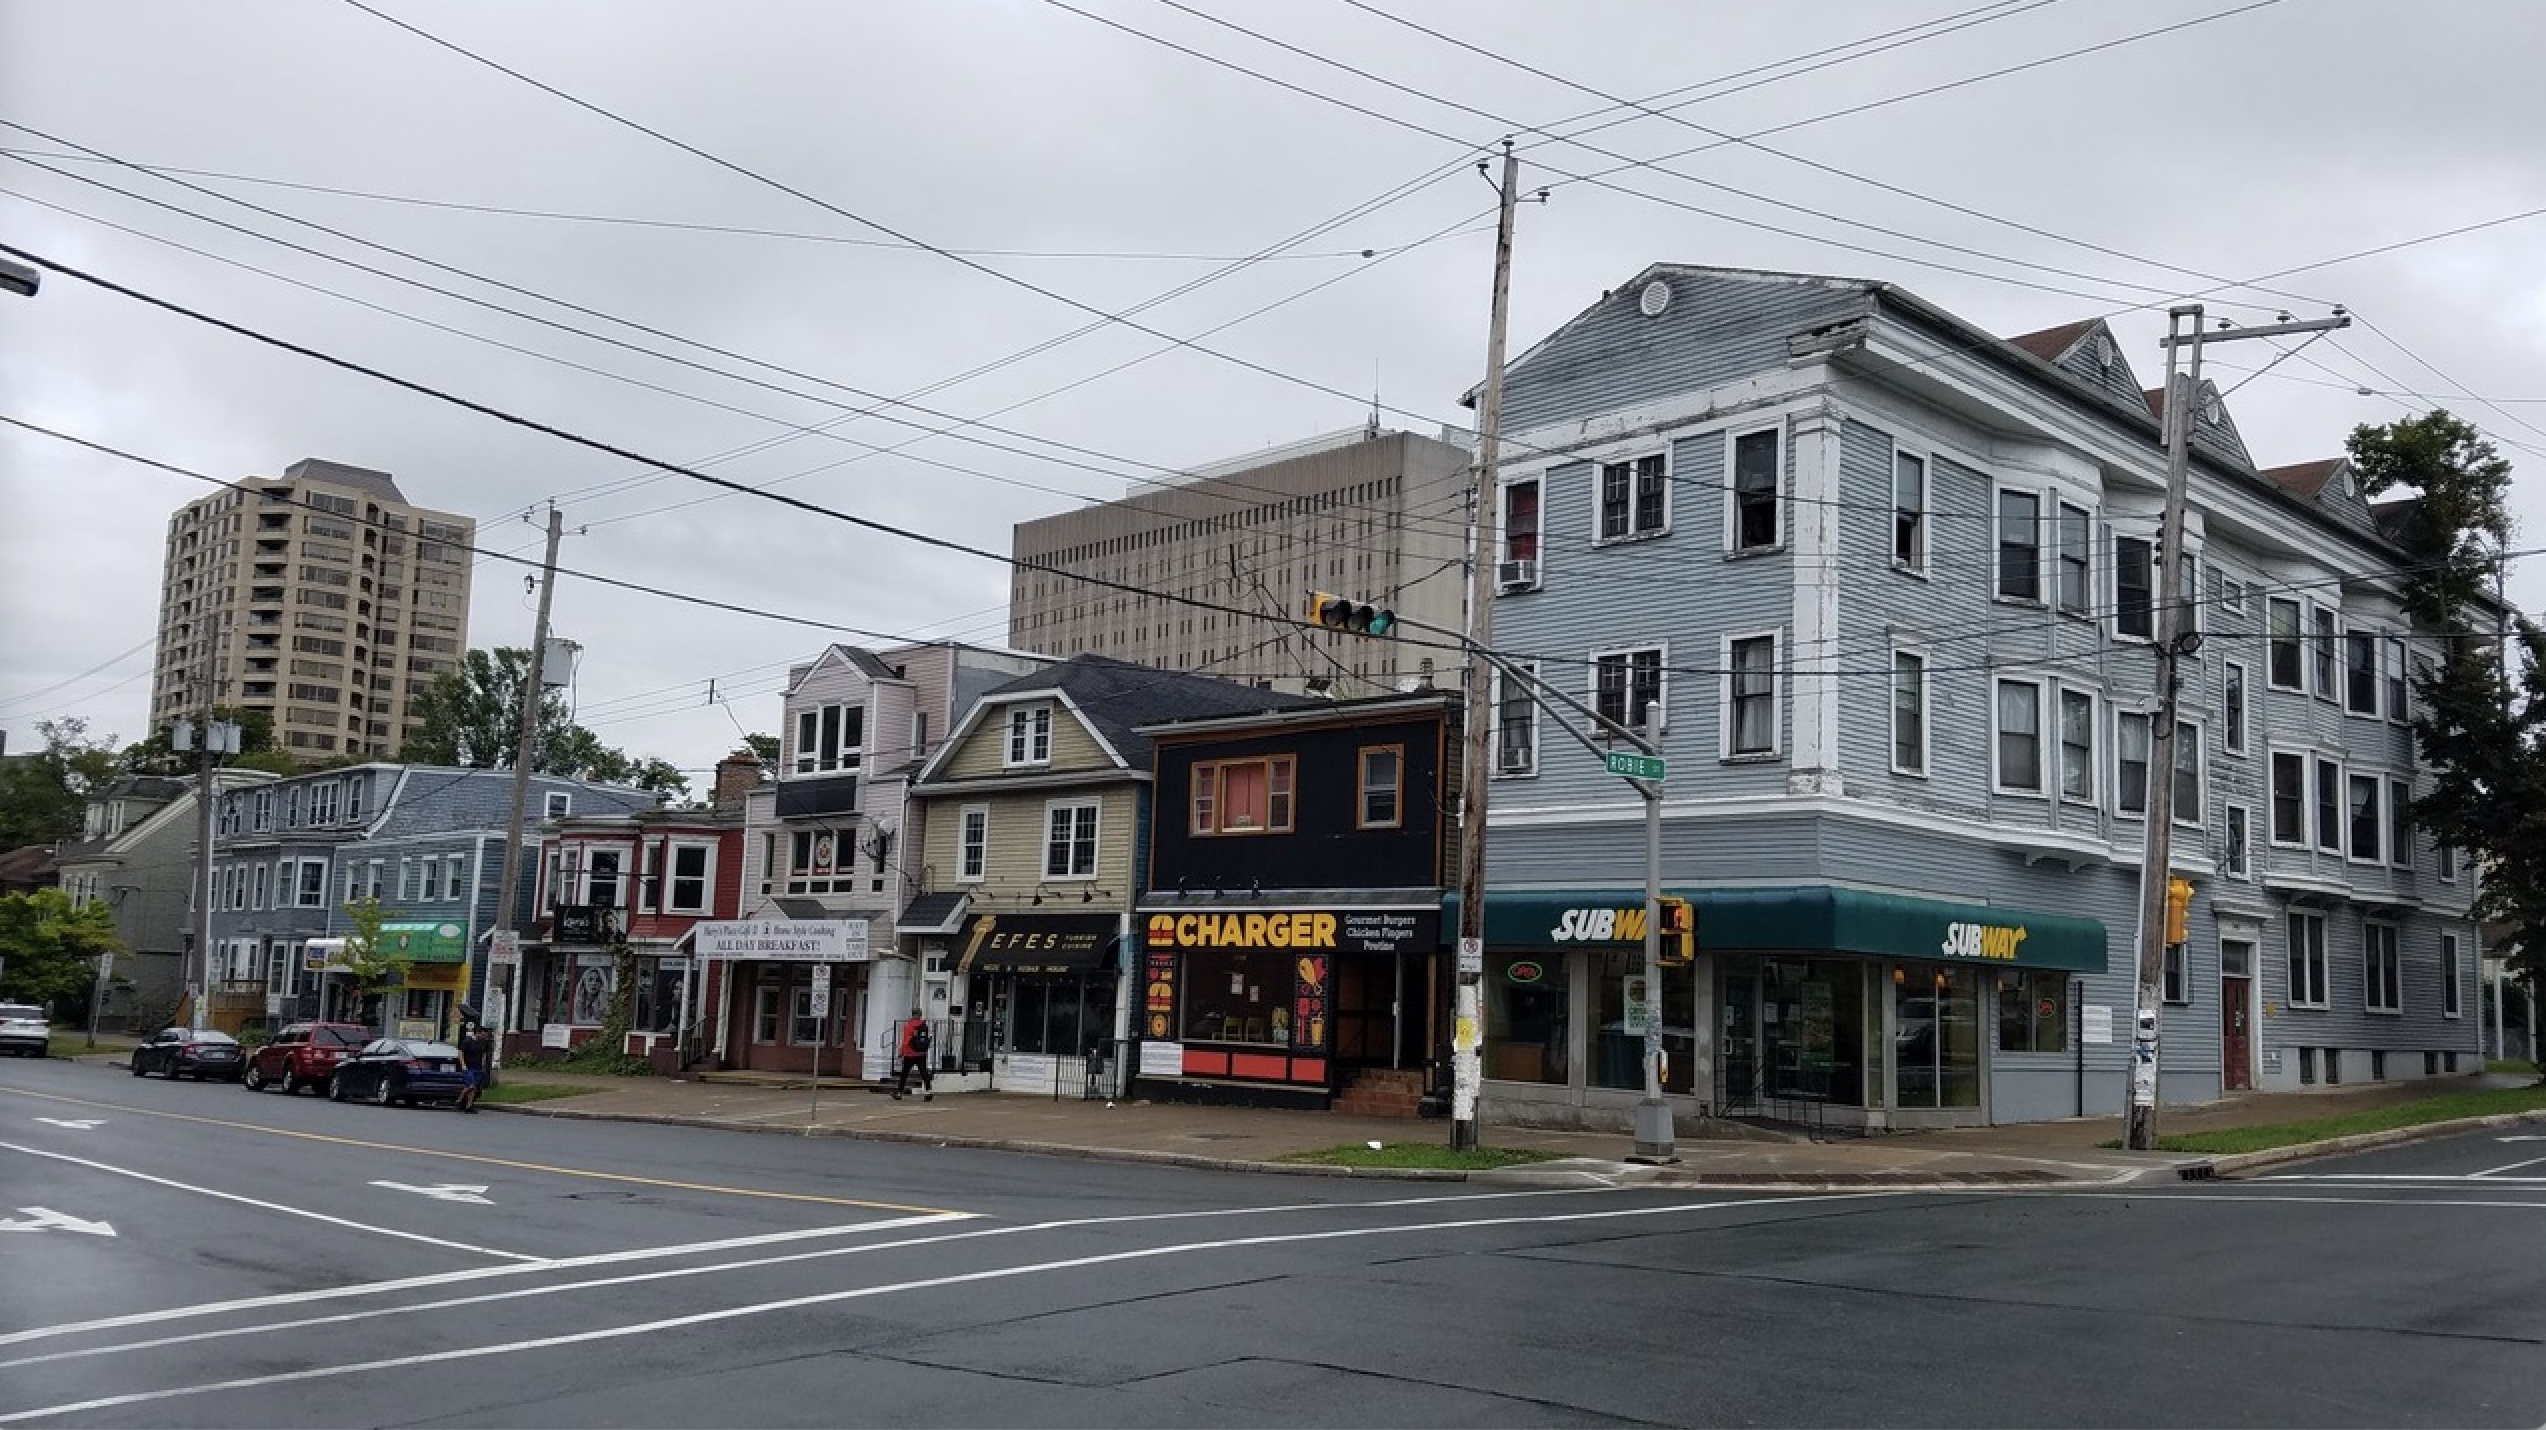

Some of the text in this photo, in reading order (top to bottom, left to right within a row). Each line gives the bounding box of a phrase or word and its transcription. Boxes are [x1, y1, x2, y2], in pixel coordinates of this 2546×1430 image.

[1611, 755, 1645, 775] ROBIE
[1344, 914, 1416, 927] Gourmet Burgers
[1176, 914, 1337, 947] CHARGER
[1345, 928, 1414, 940] Chicken Fingers
[716, 939, 821, 951] ALL DAY BREAKFAST!
[989, 933, 1058, 949] EFES
[1363, 939, 1395, 950] Poutine
[1942, 922, 2027, 959] SUBWAY
